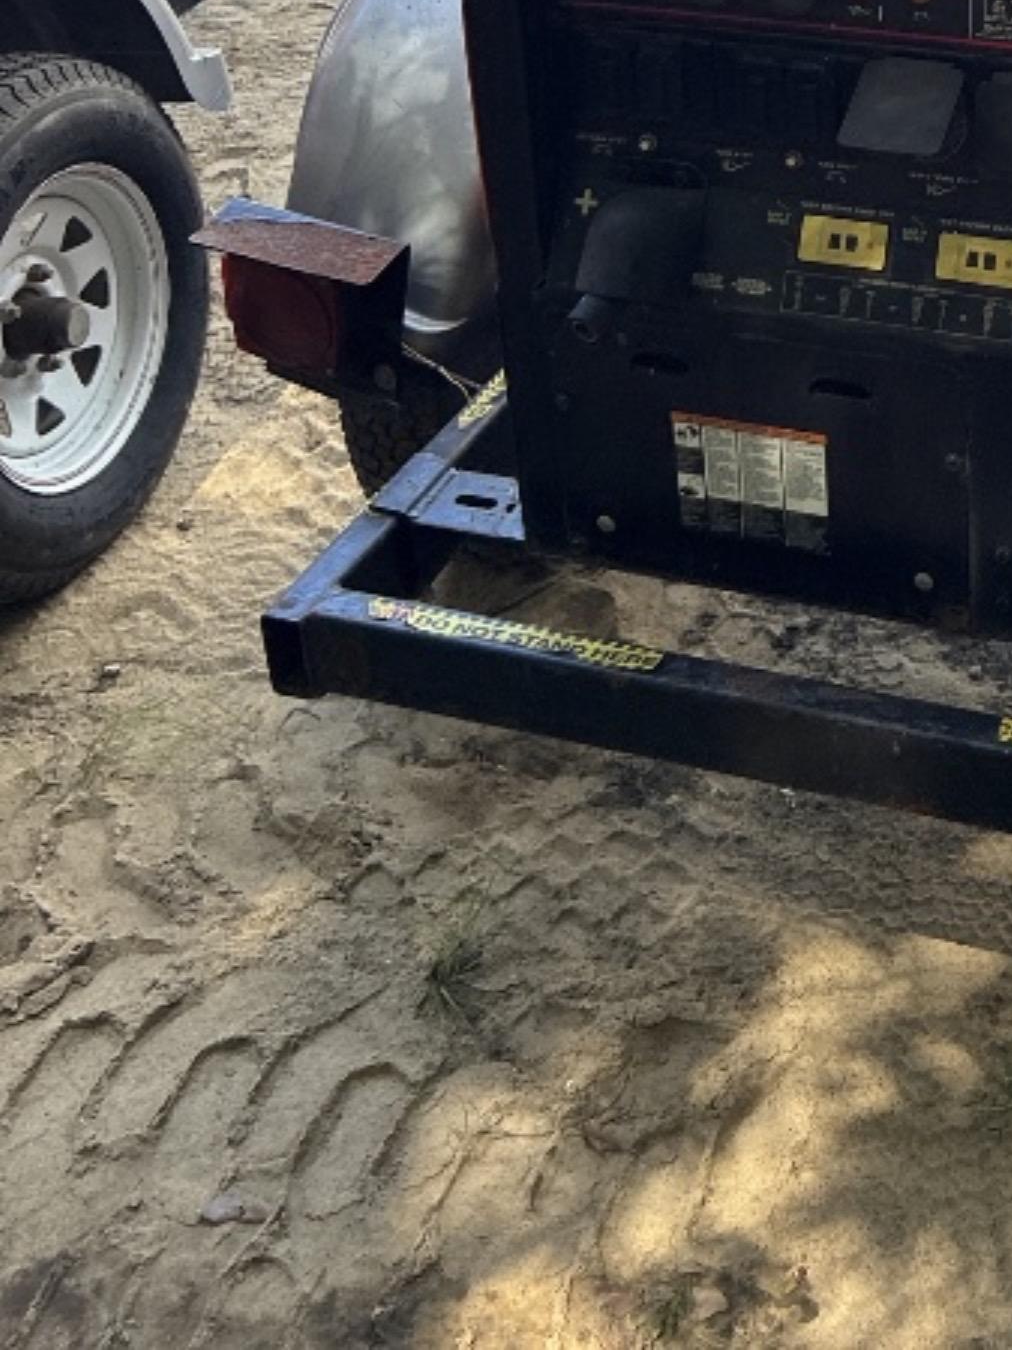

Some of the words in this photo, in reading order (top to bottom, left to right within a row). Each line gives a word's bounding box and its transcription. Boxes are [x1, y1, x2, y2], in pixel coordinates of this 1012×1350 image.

[413, 613, 448, 631] DO
[453, 623, 501, 641] NOT
[507, 632, 585, 652] STAND
[590, 647, 658, 667] HERE
